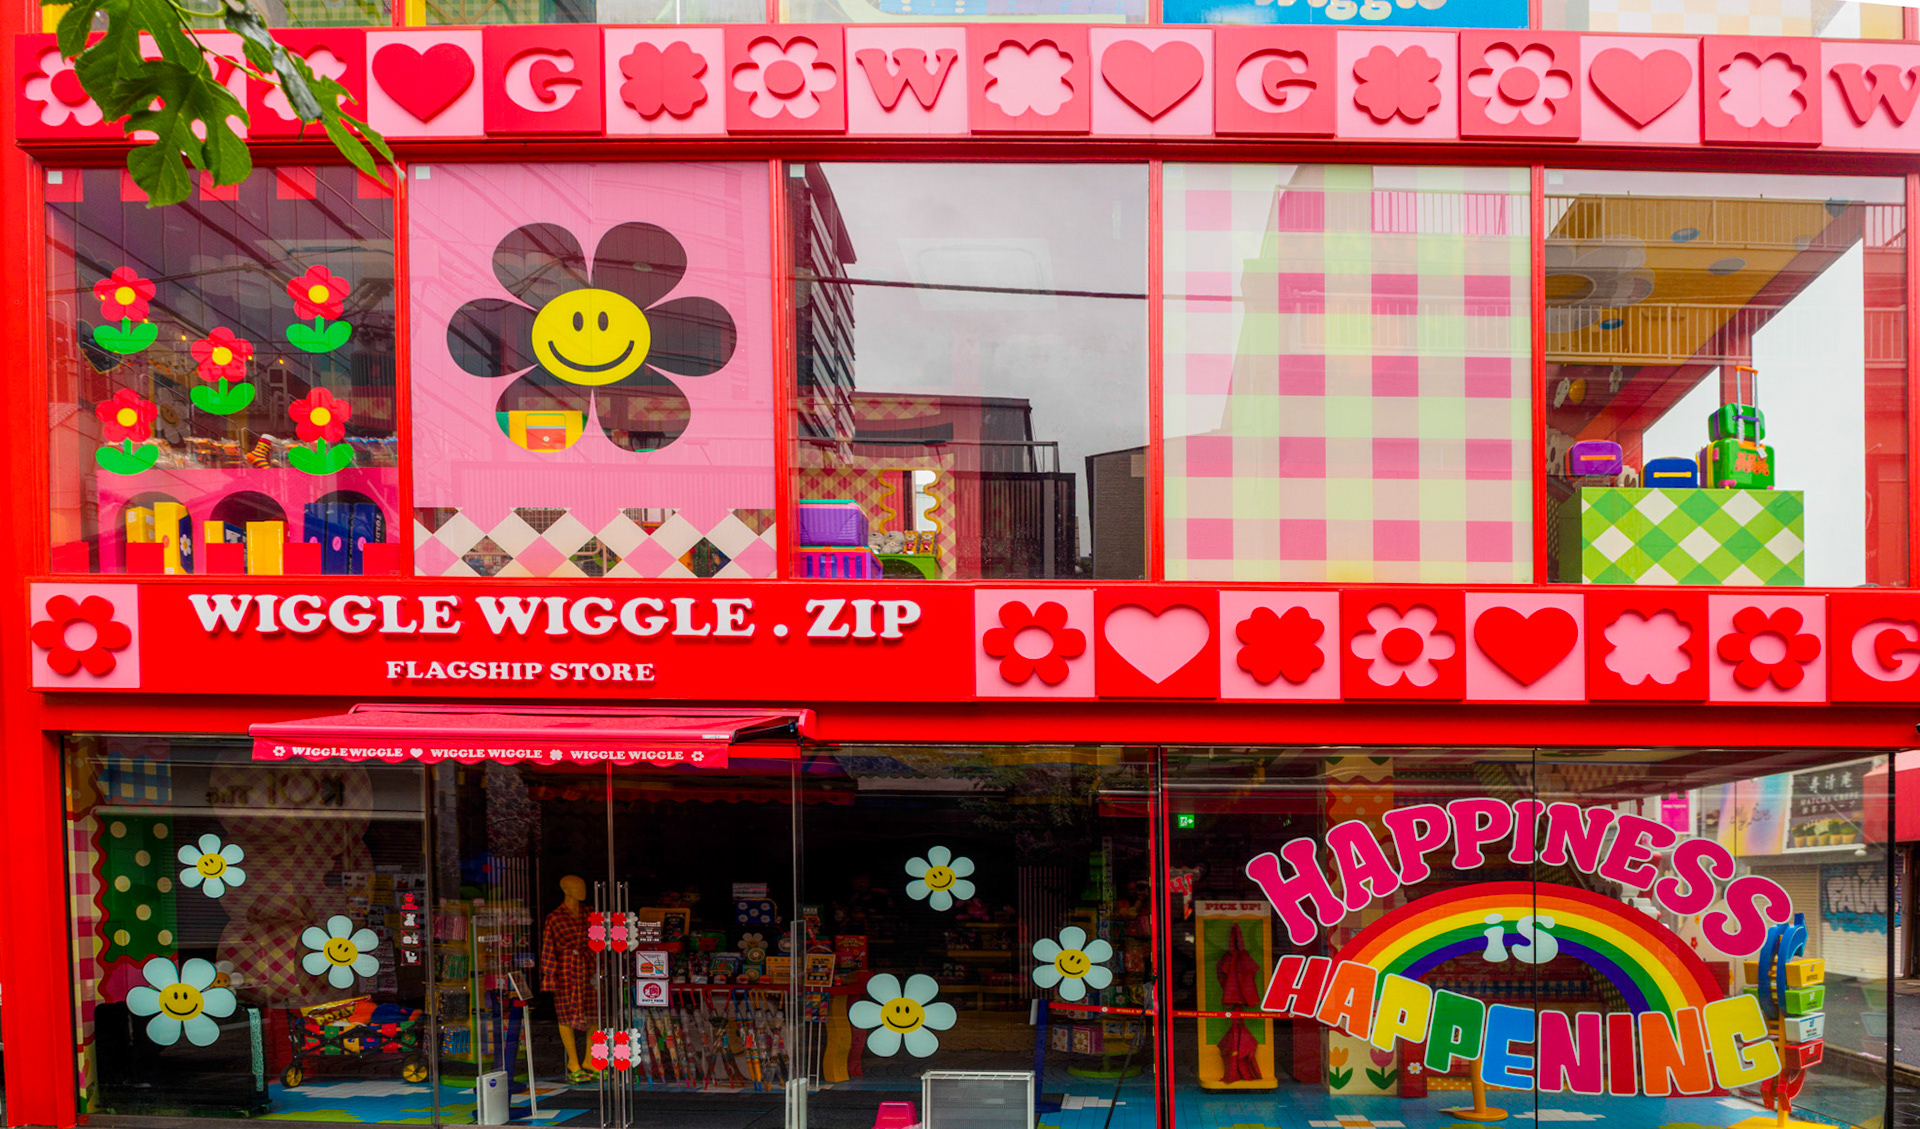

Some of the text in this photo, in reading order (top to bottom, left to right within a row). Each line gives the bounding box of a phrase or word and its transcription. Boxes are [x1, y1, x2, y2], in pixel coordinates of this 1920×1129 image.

[503, 48, 583, 112] G
[855, 48, 958, 112] W
[1235, 48, 1317, 113] G
[1830, 63, 1920, 126] W
[189, 594, 462, 635] WIGGLE
[476, 596, 756, 637] WIGGLE
[805, 598, 922, 639] ZIP
[386, 660, 656, 682] FLAGSHIP STORE
[1851, 617, 1920, 682] G
[292, 746, 404, 758] WIGGLE WIGGLE
[430, 748, 542, 759] WIGGLE WIGGLE
[571, 750, 684, 761] WIGGLE WIGGLE
[1205, 903, 1262, 911] PICK UP!
[1246, 797, 1791, 957] HAPPINESS
[1261, 954, 1782, 1097] HAPPENING
